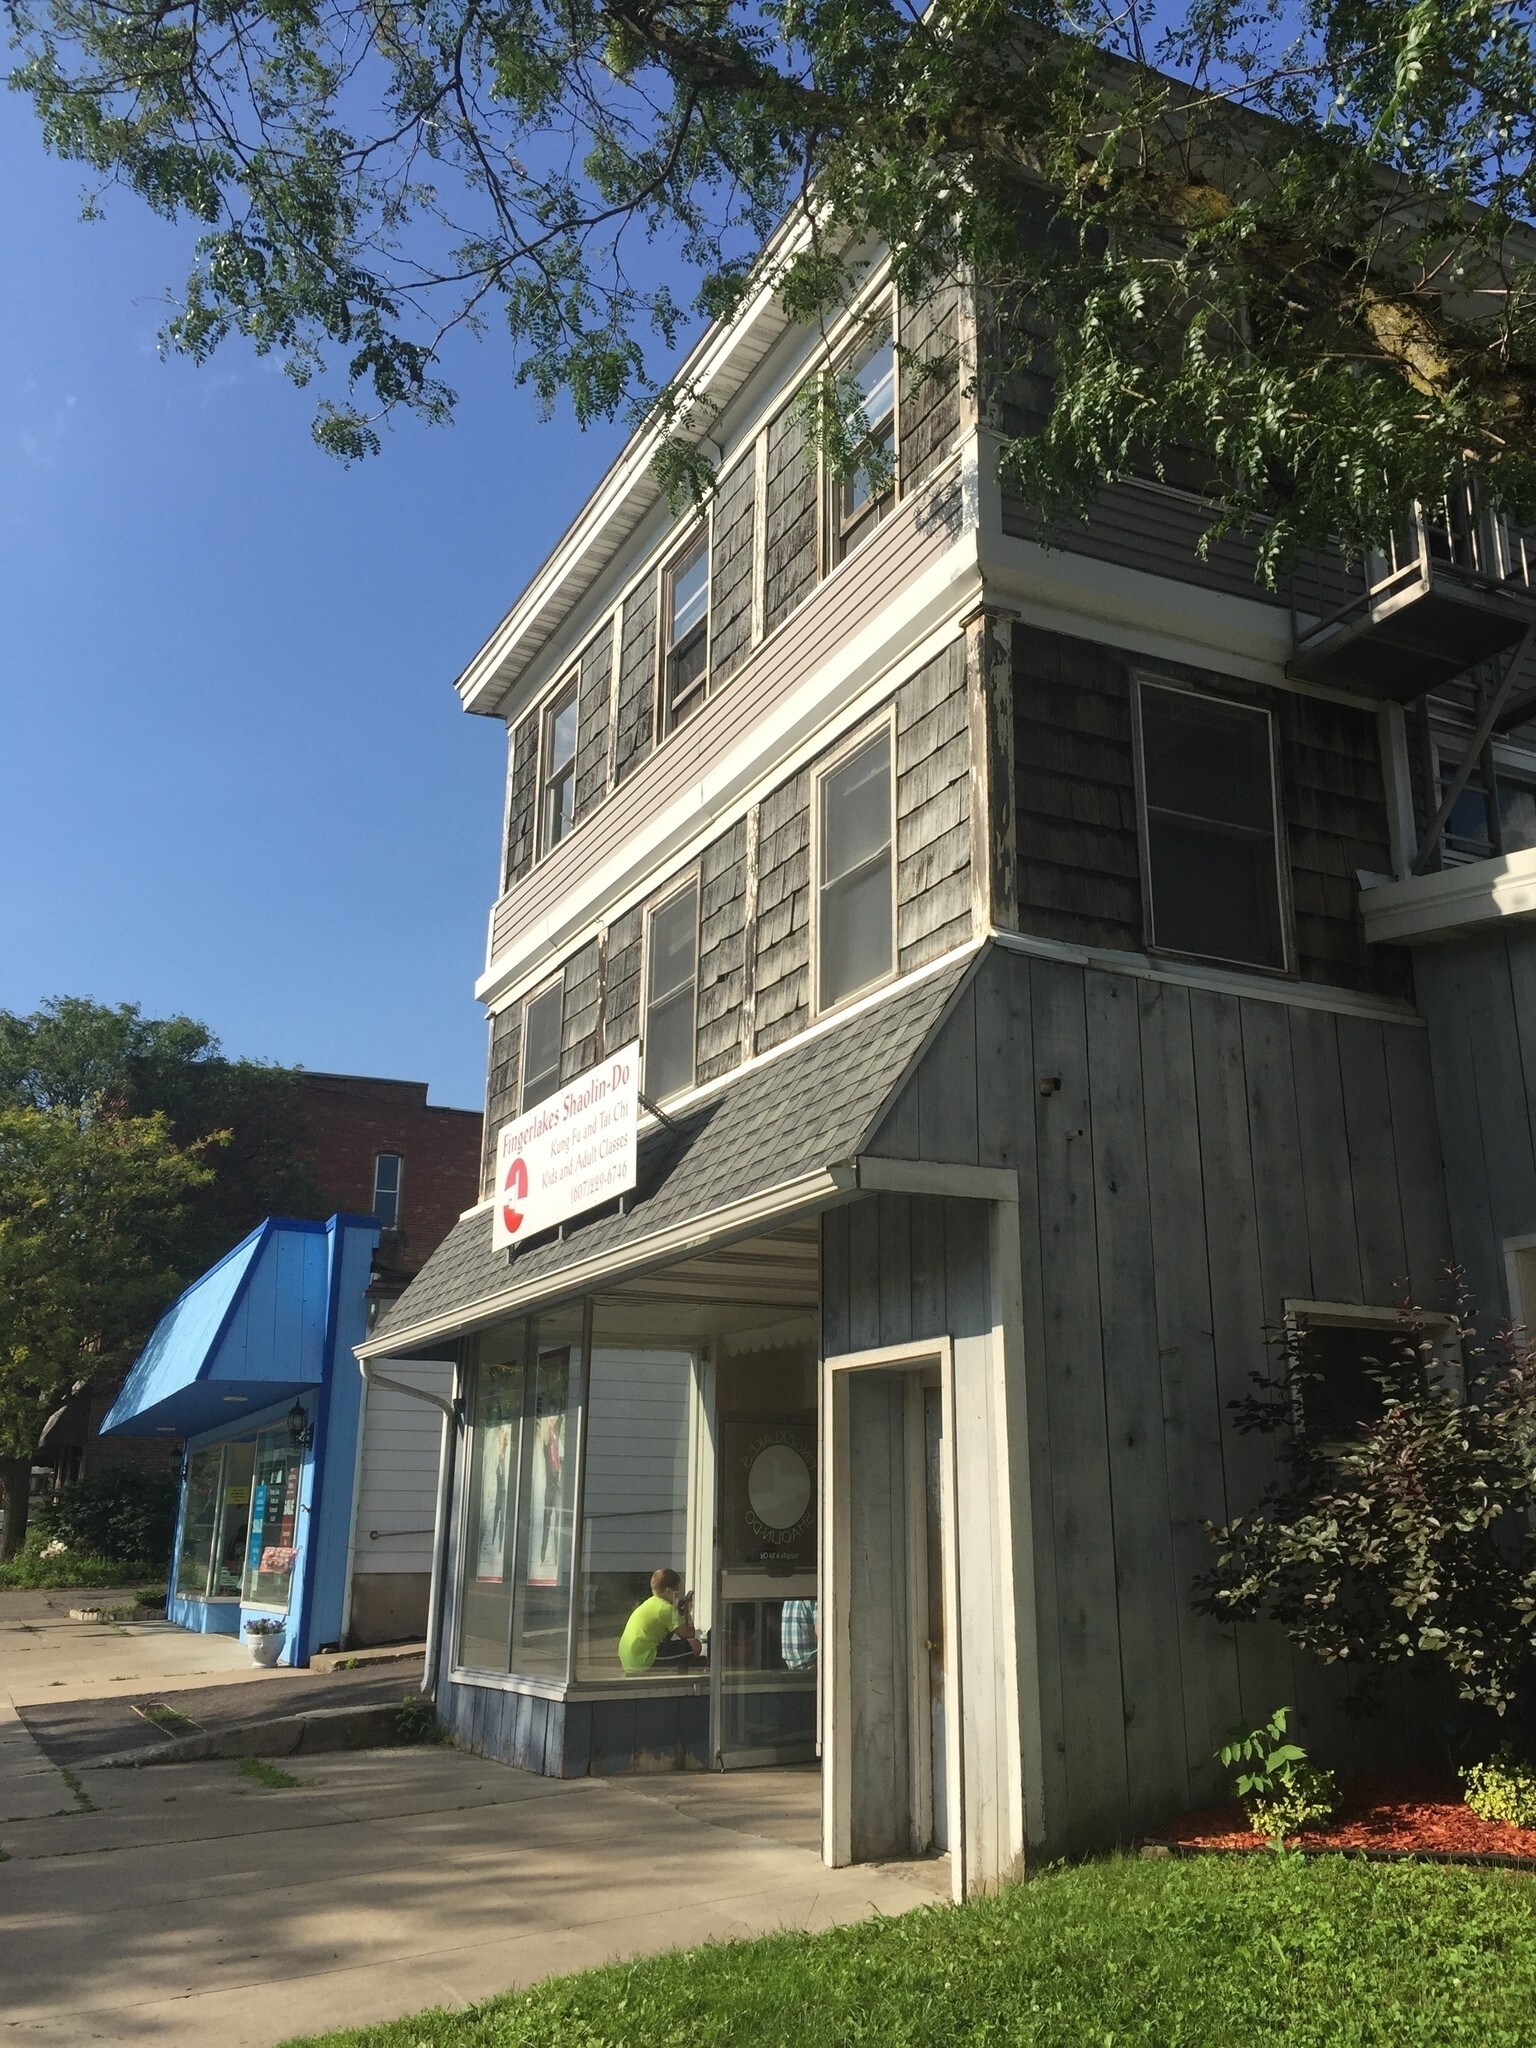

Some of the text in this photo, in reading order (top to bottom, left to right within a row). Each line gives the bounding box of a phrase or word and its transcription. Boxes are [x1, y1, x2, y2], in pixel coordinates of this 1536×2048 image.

[502, 1064, 630, 1158] Fingerlakes Shaolin-Do
[550, 1101, 629, 1157] Kung Fu and Tai Chi
[541, 1133, 628, 1189] Kids and Adult Classes
